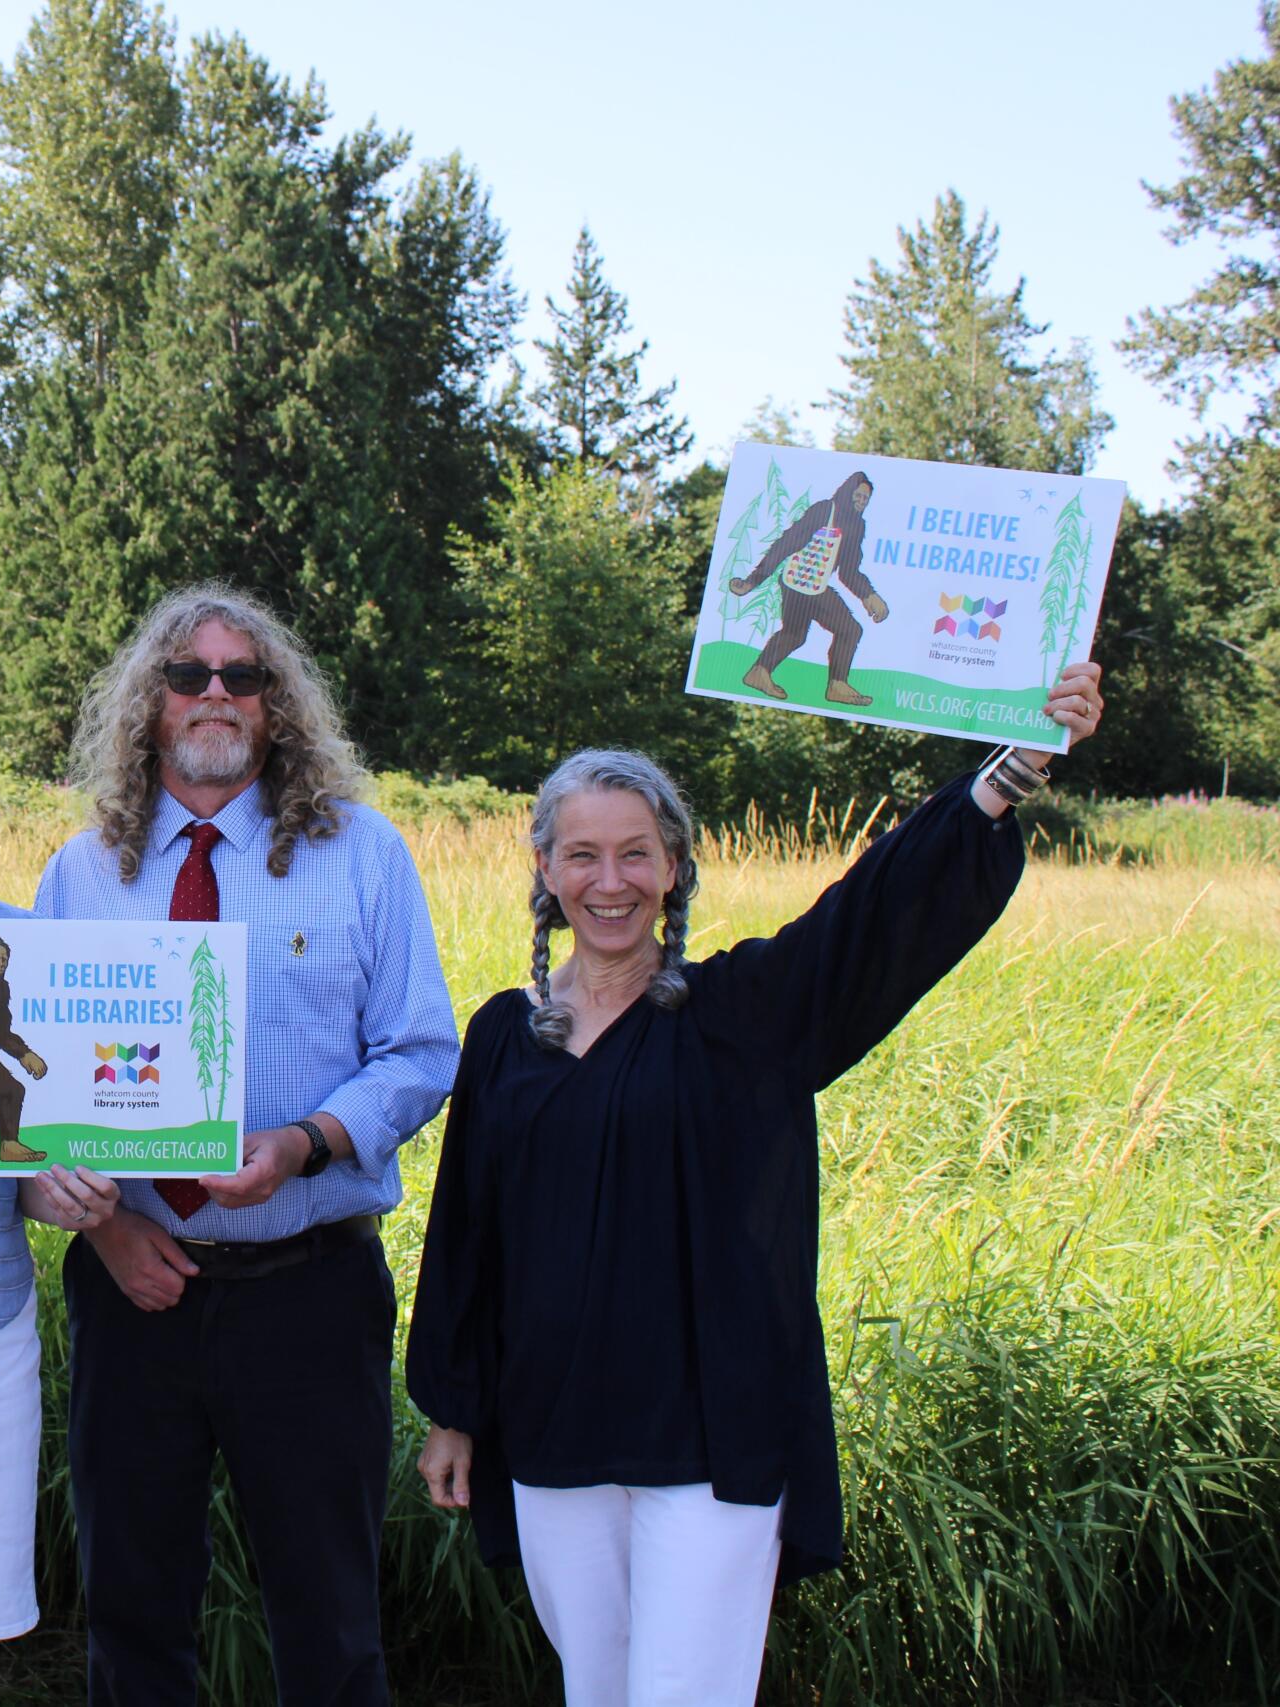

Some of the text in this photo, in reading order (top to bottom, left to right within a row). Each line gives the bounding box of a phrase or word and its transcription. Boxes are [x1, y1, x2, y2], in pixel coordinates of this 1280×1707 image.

[907, 505, 1020, 543] I BELIEVE
[873, 538, 1040, 583] IN LIBRARIES!
[928, 650, 995, 667] library system
[931, 641, 997, 658] whatcom county
[49, 963, 157, 989] I BELIEVE
[22, 998, 183, 1025] IN LIBRARIES!
[94, 1090, 160, 1099] whatcom county
[94, 1099, 160, 1110] library system
[68, 1140, 227, 1160] WCLS.ORG/GETACARD
